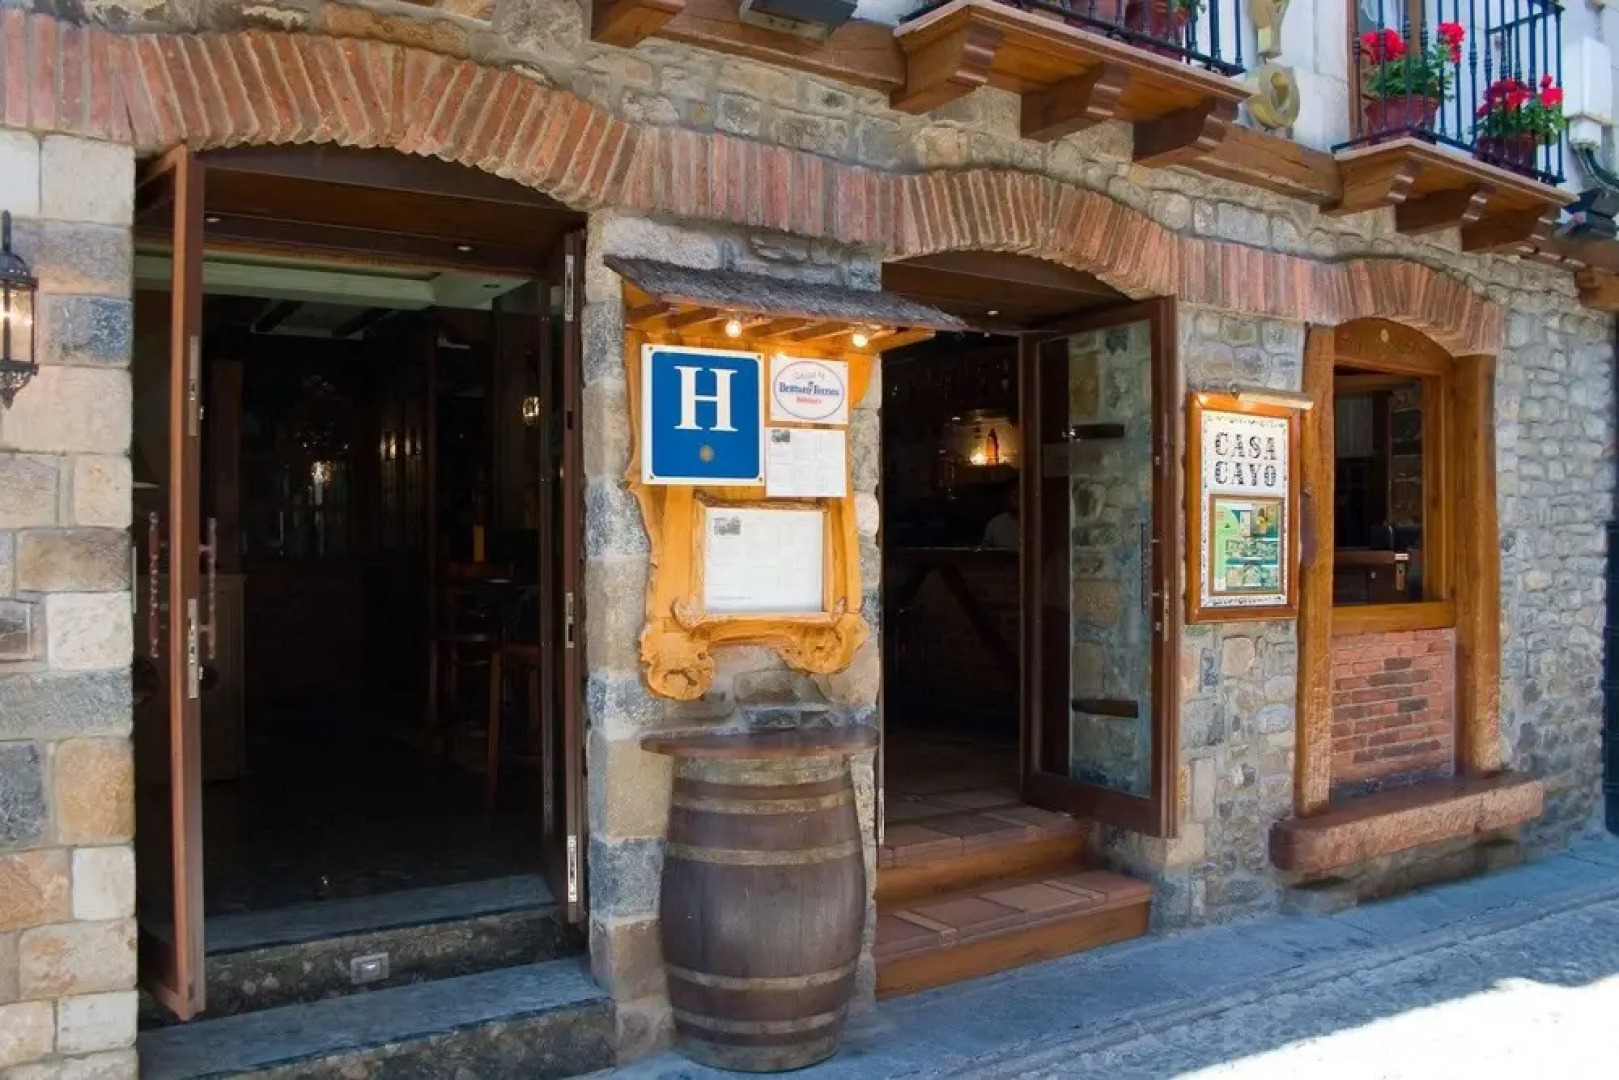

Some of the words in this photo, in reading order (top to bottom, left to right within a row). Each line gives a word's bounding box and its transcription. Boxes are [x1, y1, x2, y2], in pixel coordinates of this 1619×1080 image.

[673, 365, 739, 432] H
[1214, 431, 1277, 460] CASA
[1214, 461, 1277, 487] CAYO
